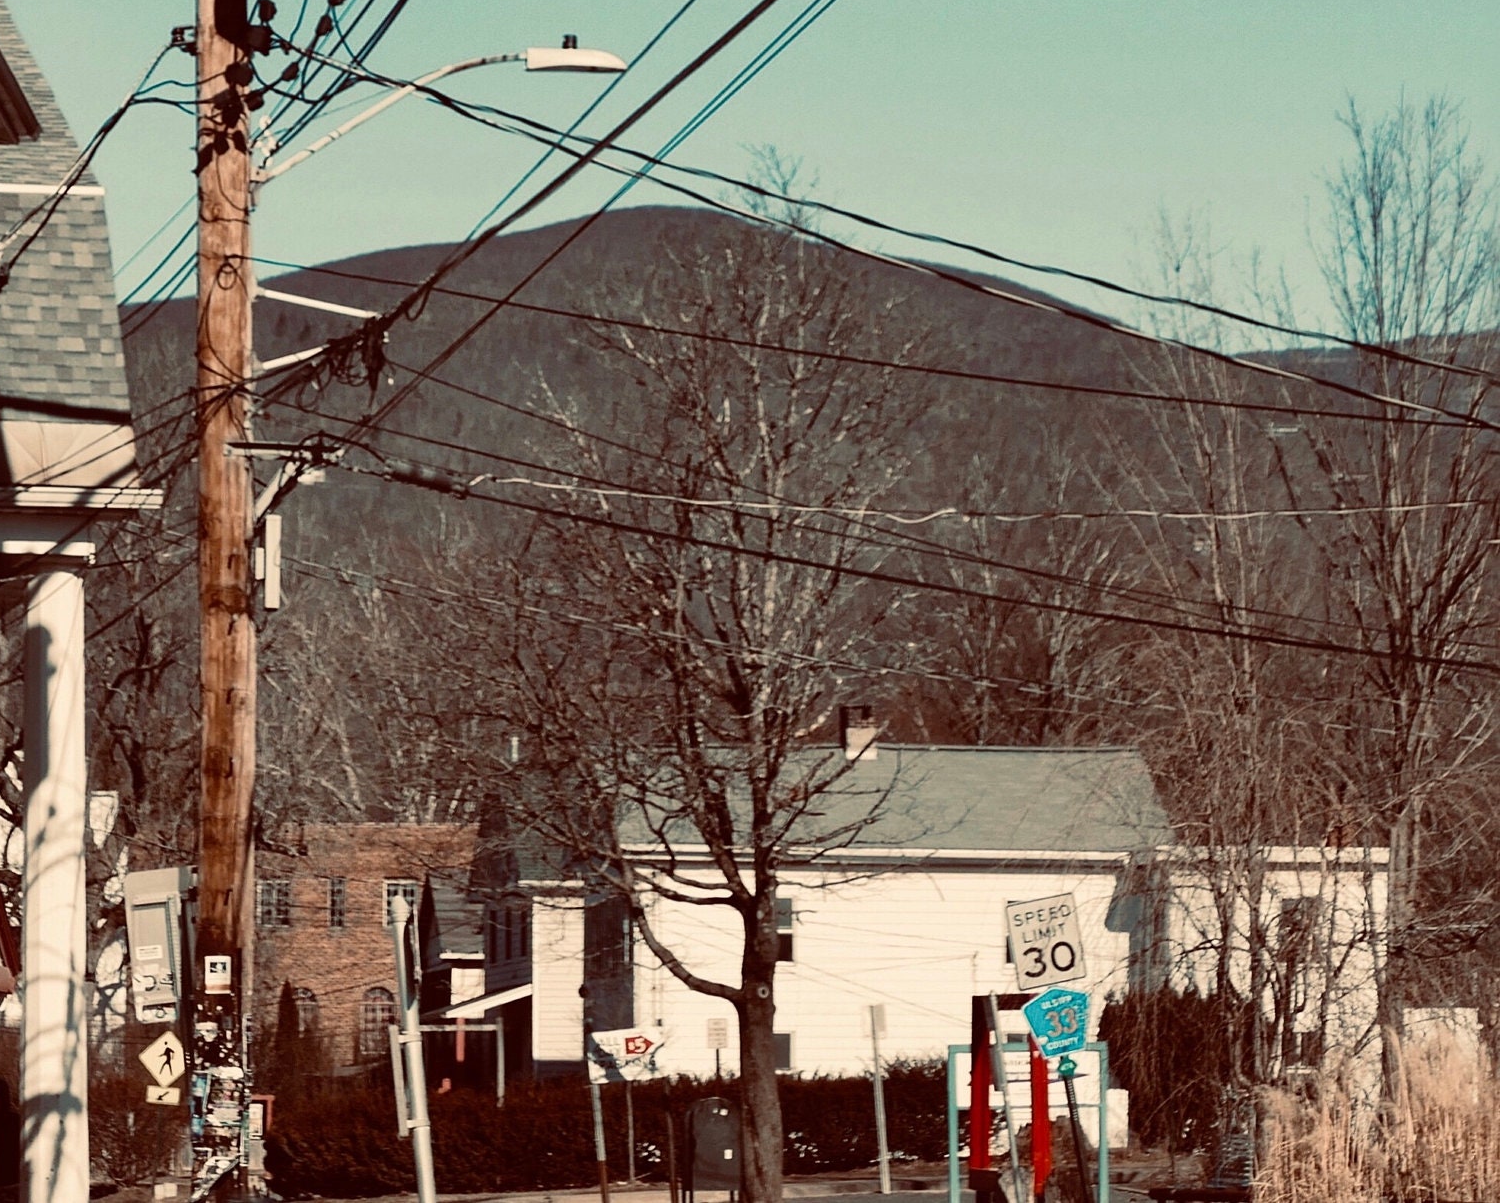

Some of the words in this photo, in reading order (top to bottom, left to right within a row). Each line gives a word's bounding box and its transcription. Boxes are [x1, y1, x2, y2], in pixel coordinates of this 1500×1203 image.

[1013, 904, 1071, 927] SPEED
[1022, 922, 1065, 943] LIMIT
[1023, 941, 1076, 978] 30
[1045, 1008, 1078, 1037] 33
[1045, 1037, 1079, 1050] COUNTY
